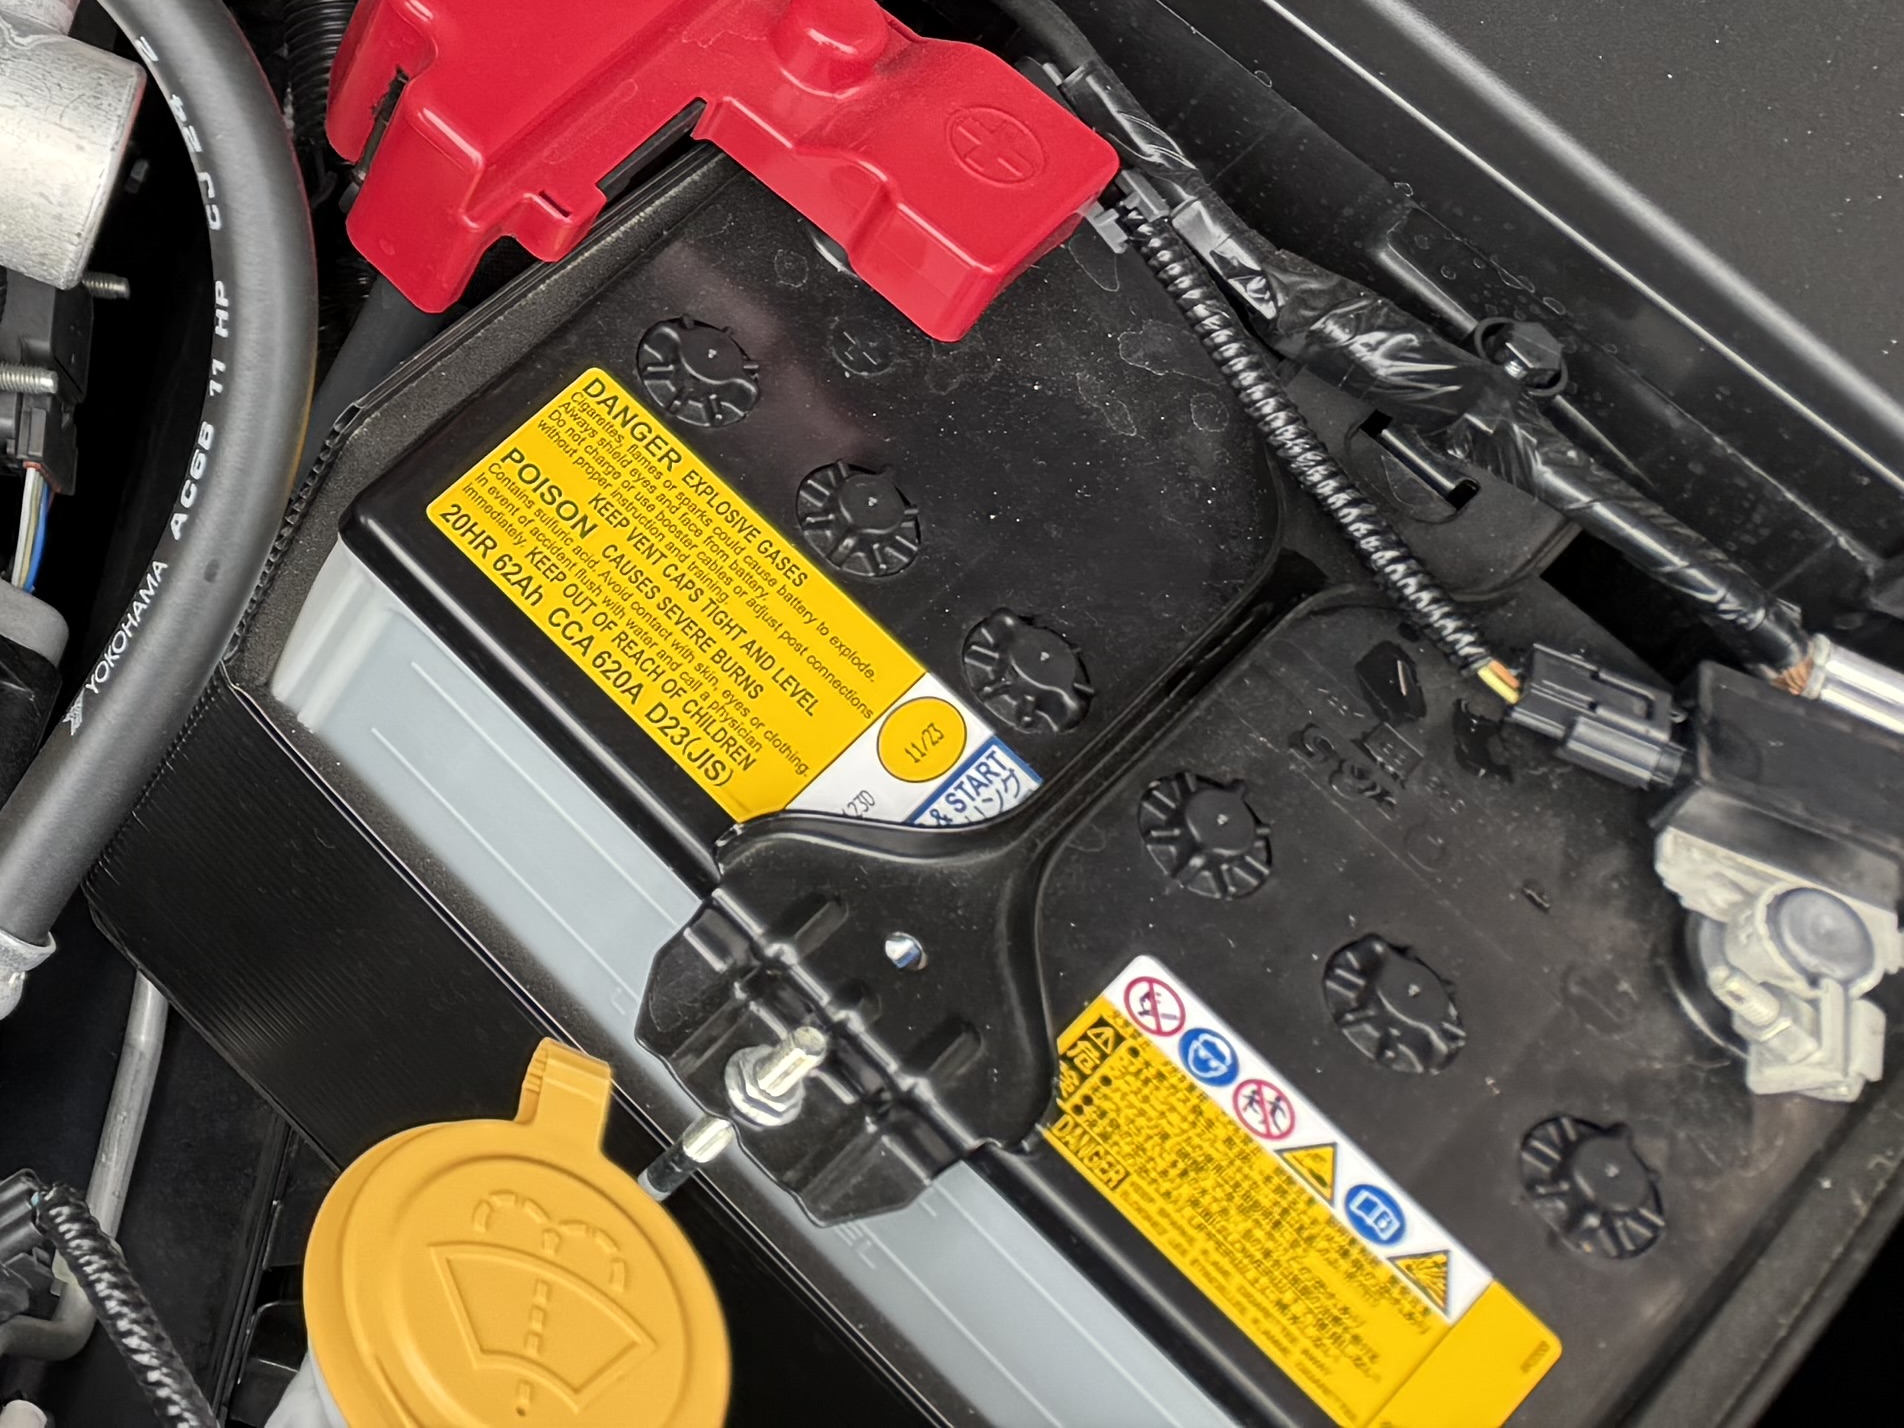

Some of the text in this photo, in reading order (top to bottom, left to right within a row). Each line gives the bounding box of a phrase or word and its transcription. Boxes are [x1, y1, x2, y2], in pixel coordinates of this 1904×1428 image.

[168, 90, 205, 156] 24
[207, 357, 228, 399] 11
[213, 278, 232, 341] HP
[167, 420, 217, 543] AC6B
[498, 446, 764, 700] POISON CAUSES SEVERE BURNS
[536, 418, 730, 605] without proper instruction and training.
[546, 408, 874, 720] Do not charge or use booster cables or adjust post connections
[557, 400, 599, 438] Always
[595, 436, 634, 469] shield
[628, 466, 658, 495] eyes
[654, 492, 681, 515] and
[676, 510, 703, 538] face
[701, 534, 730, 563] from
[581, 376, 808, 588] DANGER EXPLOSIVE GASES
[624, 442, 664, 481] flames
[661, 478, 678, 491] or
[673, 490, 713, 528] sparks
[711, 525, 747, 556] could
[742, 554, 778, 588] cause
[775, 583, 818, 625] battery
[815, 620, 830, 636] to
[828, 634, 875, 683] explode.
[84, 558, 170, 697] YOKOHAMA
[438, 502, 734, 787] 20HR 62Ah CCA 620A D23(JIS)
[473, 470, 489, 488] In
[486, 485, 521, 517] event
[516, 514, 535, 528] of
[528, 525, 578, 572] accident
[573, 566, 603, 597] flush
[600, 594, 626, 620] with
[624, 616, 659, 649] water
[655, 648, 683, 672] and
[678, 670, 703, 692] call
[705, 699, 763, 753] physician
[487, 461, 536, 510] Contains
[532, 507, 574, 547] sulfuric
[570, 544, 601, 572] acid.
[596, 569, 634, 602] Avoid
[629, 600, 673, 641] contact
[669, 637, 696, 664] with
[720, 688, 751, 718] eyes
[748, 715, 766, 730] or
[762, 729, 810, 777] clothing.
[523, 545, 757, 772] KEEP OUT OF REACH OF CHILDREN
[586, 491, 819, 717] KEEP VENT CAPS TIGHT AND LEVEL
[901, 720, 947, 765] 11/23
[942, 747, 1011, 816] START
[1049, 1113, 1129, 1190] DANGER
